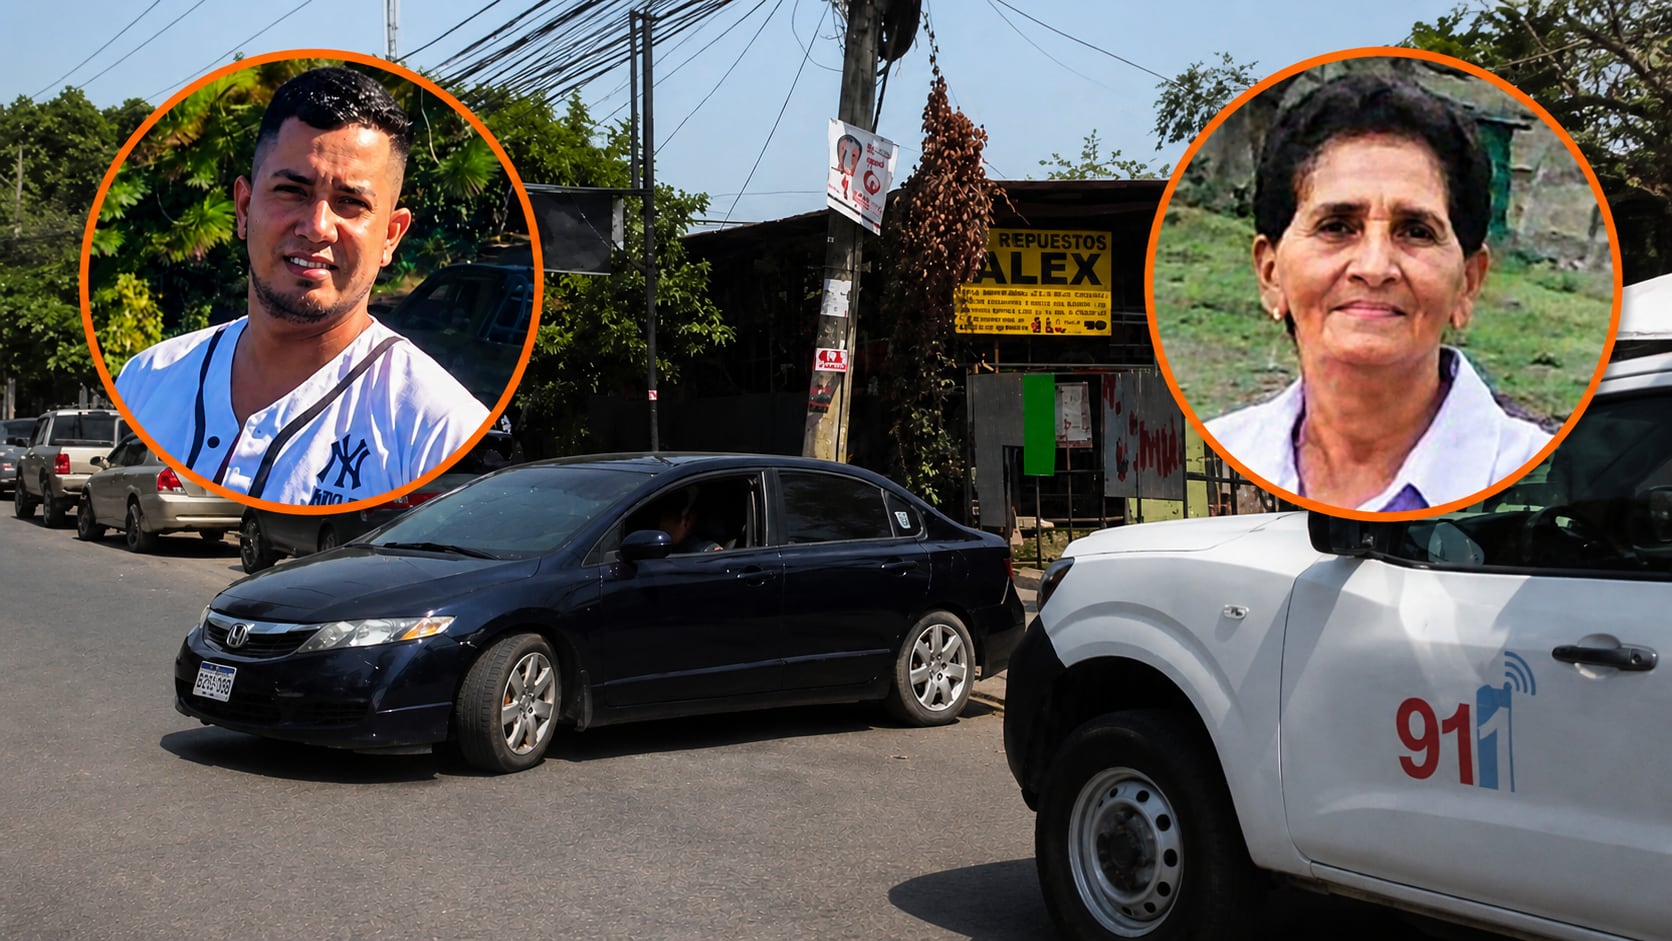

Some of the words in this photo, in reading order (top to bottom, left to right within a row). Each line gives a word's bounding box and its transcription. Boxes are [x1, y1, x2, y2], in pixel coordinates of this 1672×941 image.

[998, 232, 1106, 250] REPUESTOS
[972, 251, 1102, 286] ALEX
[316, 433, 371, 490] NY
[1396, 685, 1515, 792] 911
